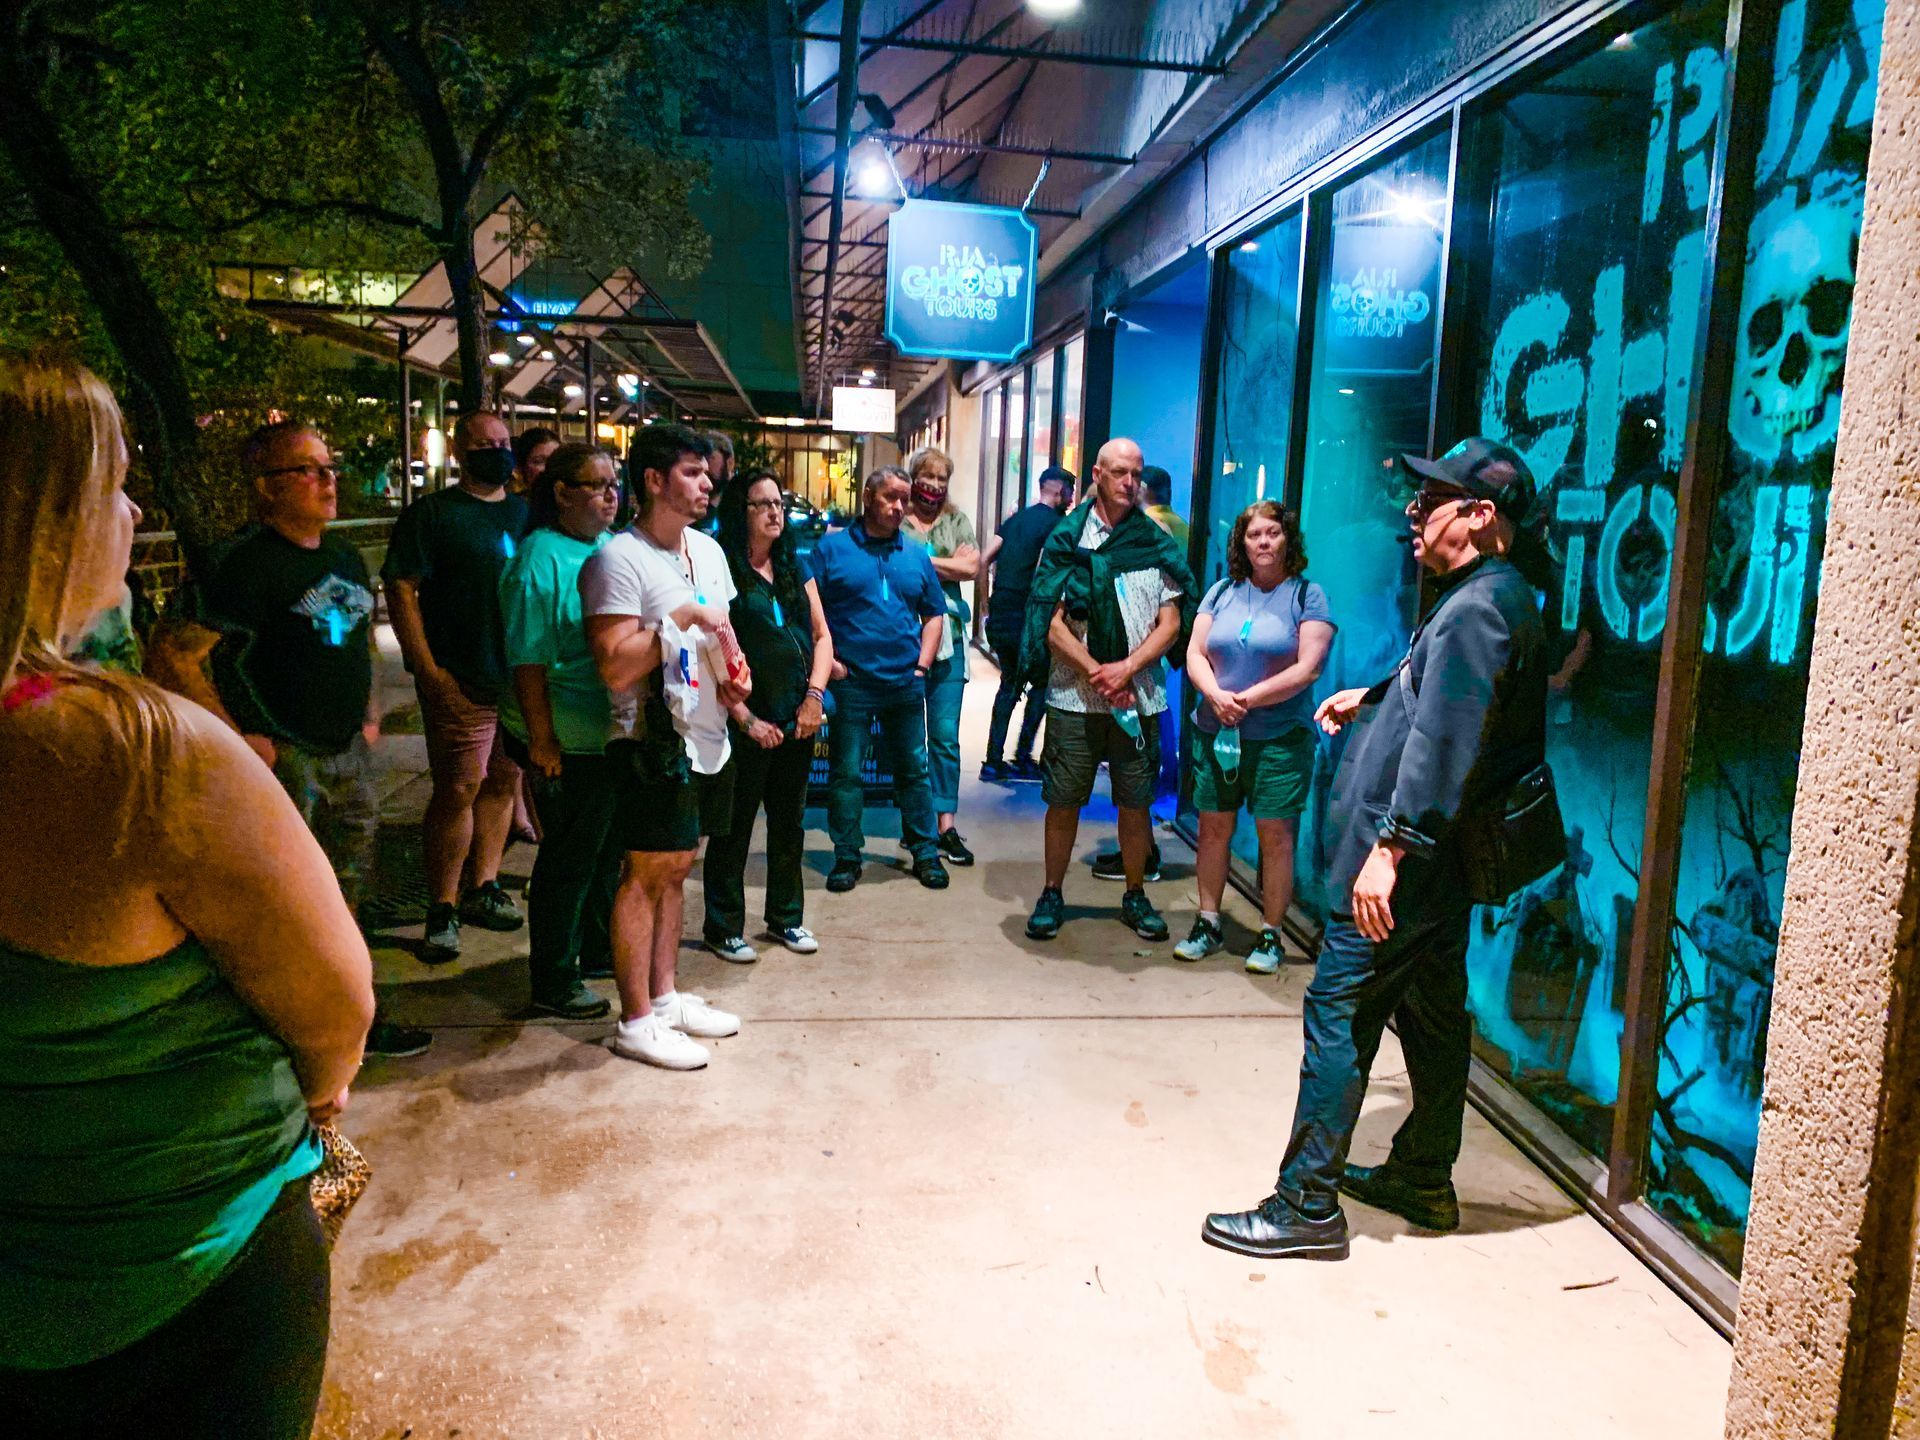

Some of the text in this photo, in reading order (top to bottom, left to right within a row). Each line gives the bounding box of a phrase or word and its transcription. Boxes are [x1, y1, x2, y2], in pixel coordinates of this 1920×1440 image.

[939, 244, 986, 268] RJA
[901, 265, 1023, 298] GHOST
[923, 295, 998, 321] TOURS
